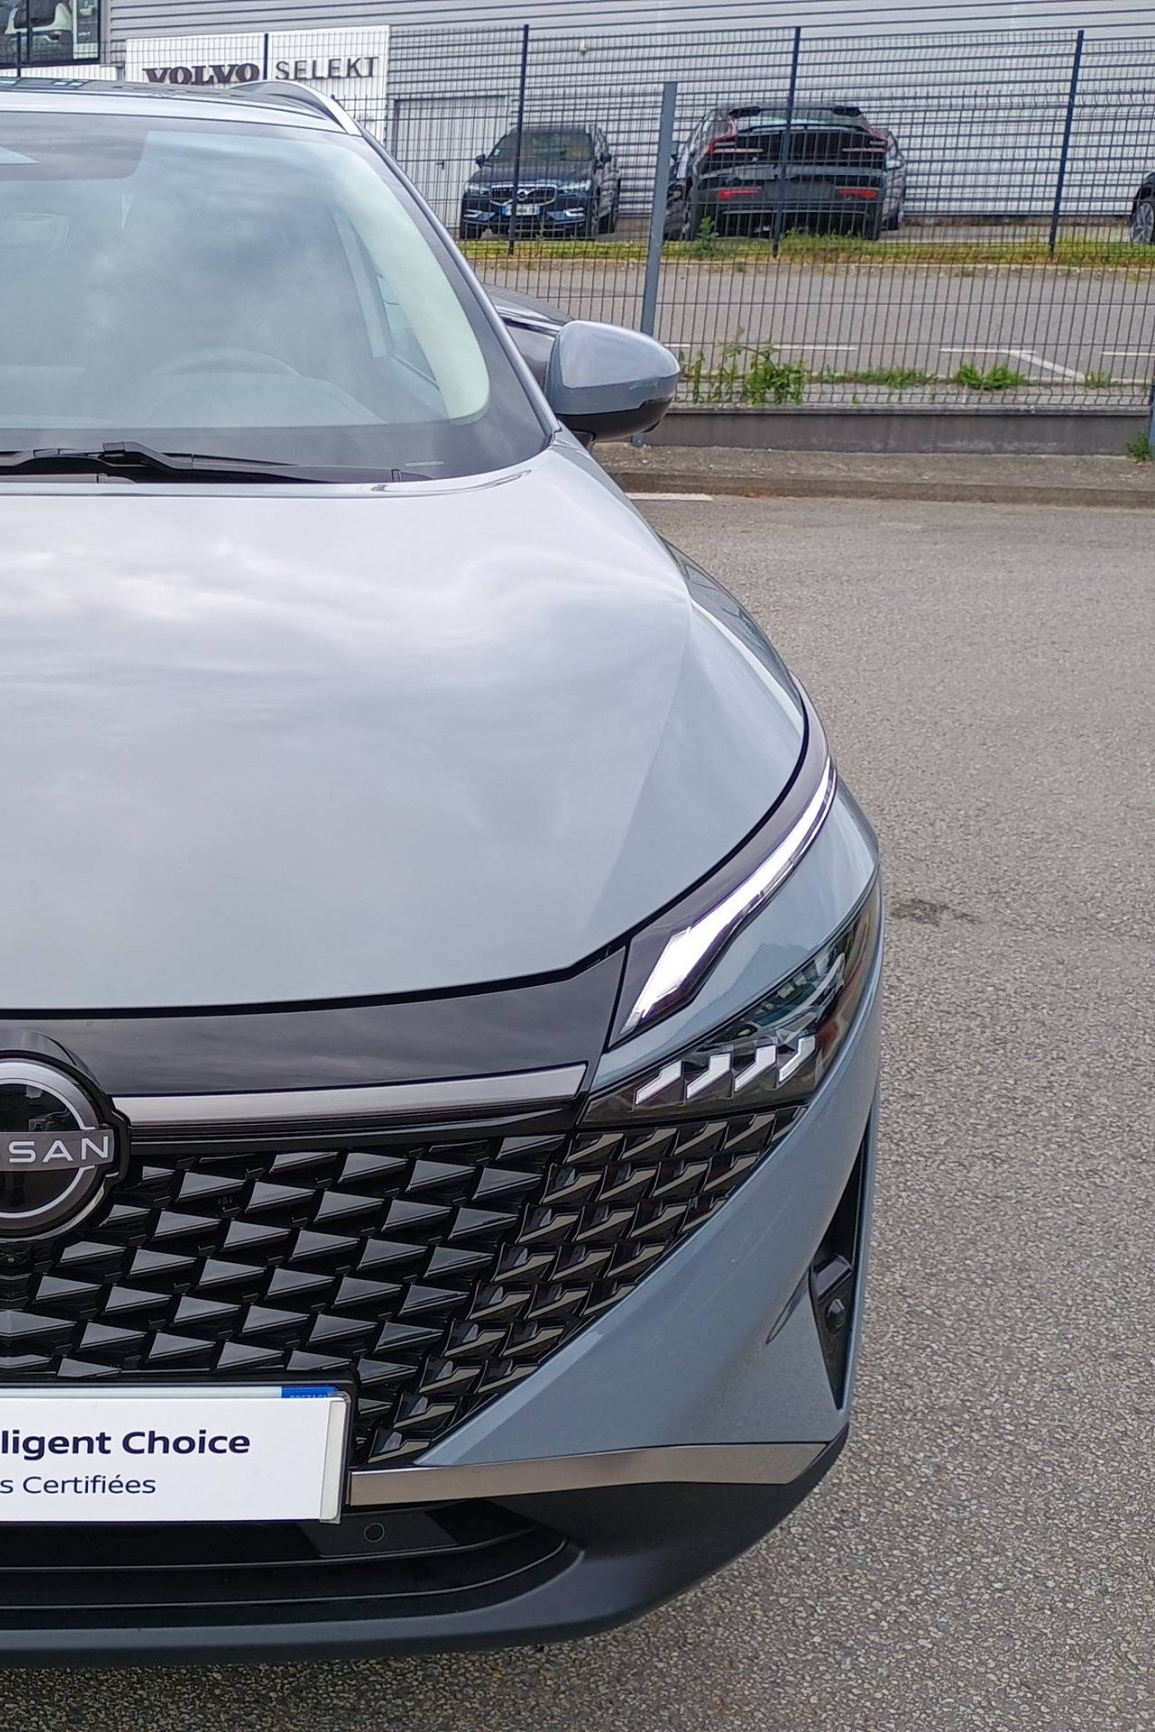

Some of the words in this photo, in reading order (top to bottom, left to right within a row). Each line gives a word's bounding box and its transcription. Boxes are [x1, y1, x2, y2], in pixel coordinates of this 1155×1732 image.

[142, 63, 260, 85] VOLVO
[275, 57, 379, 80] SELEKT
[122, 1429, 251, 1455] Choice
[22, 1472, 157, 1495] Certifiées
